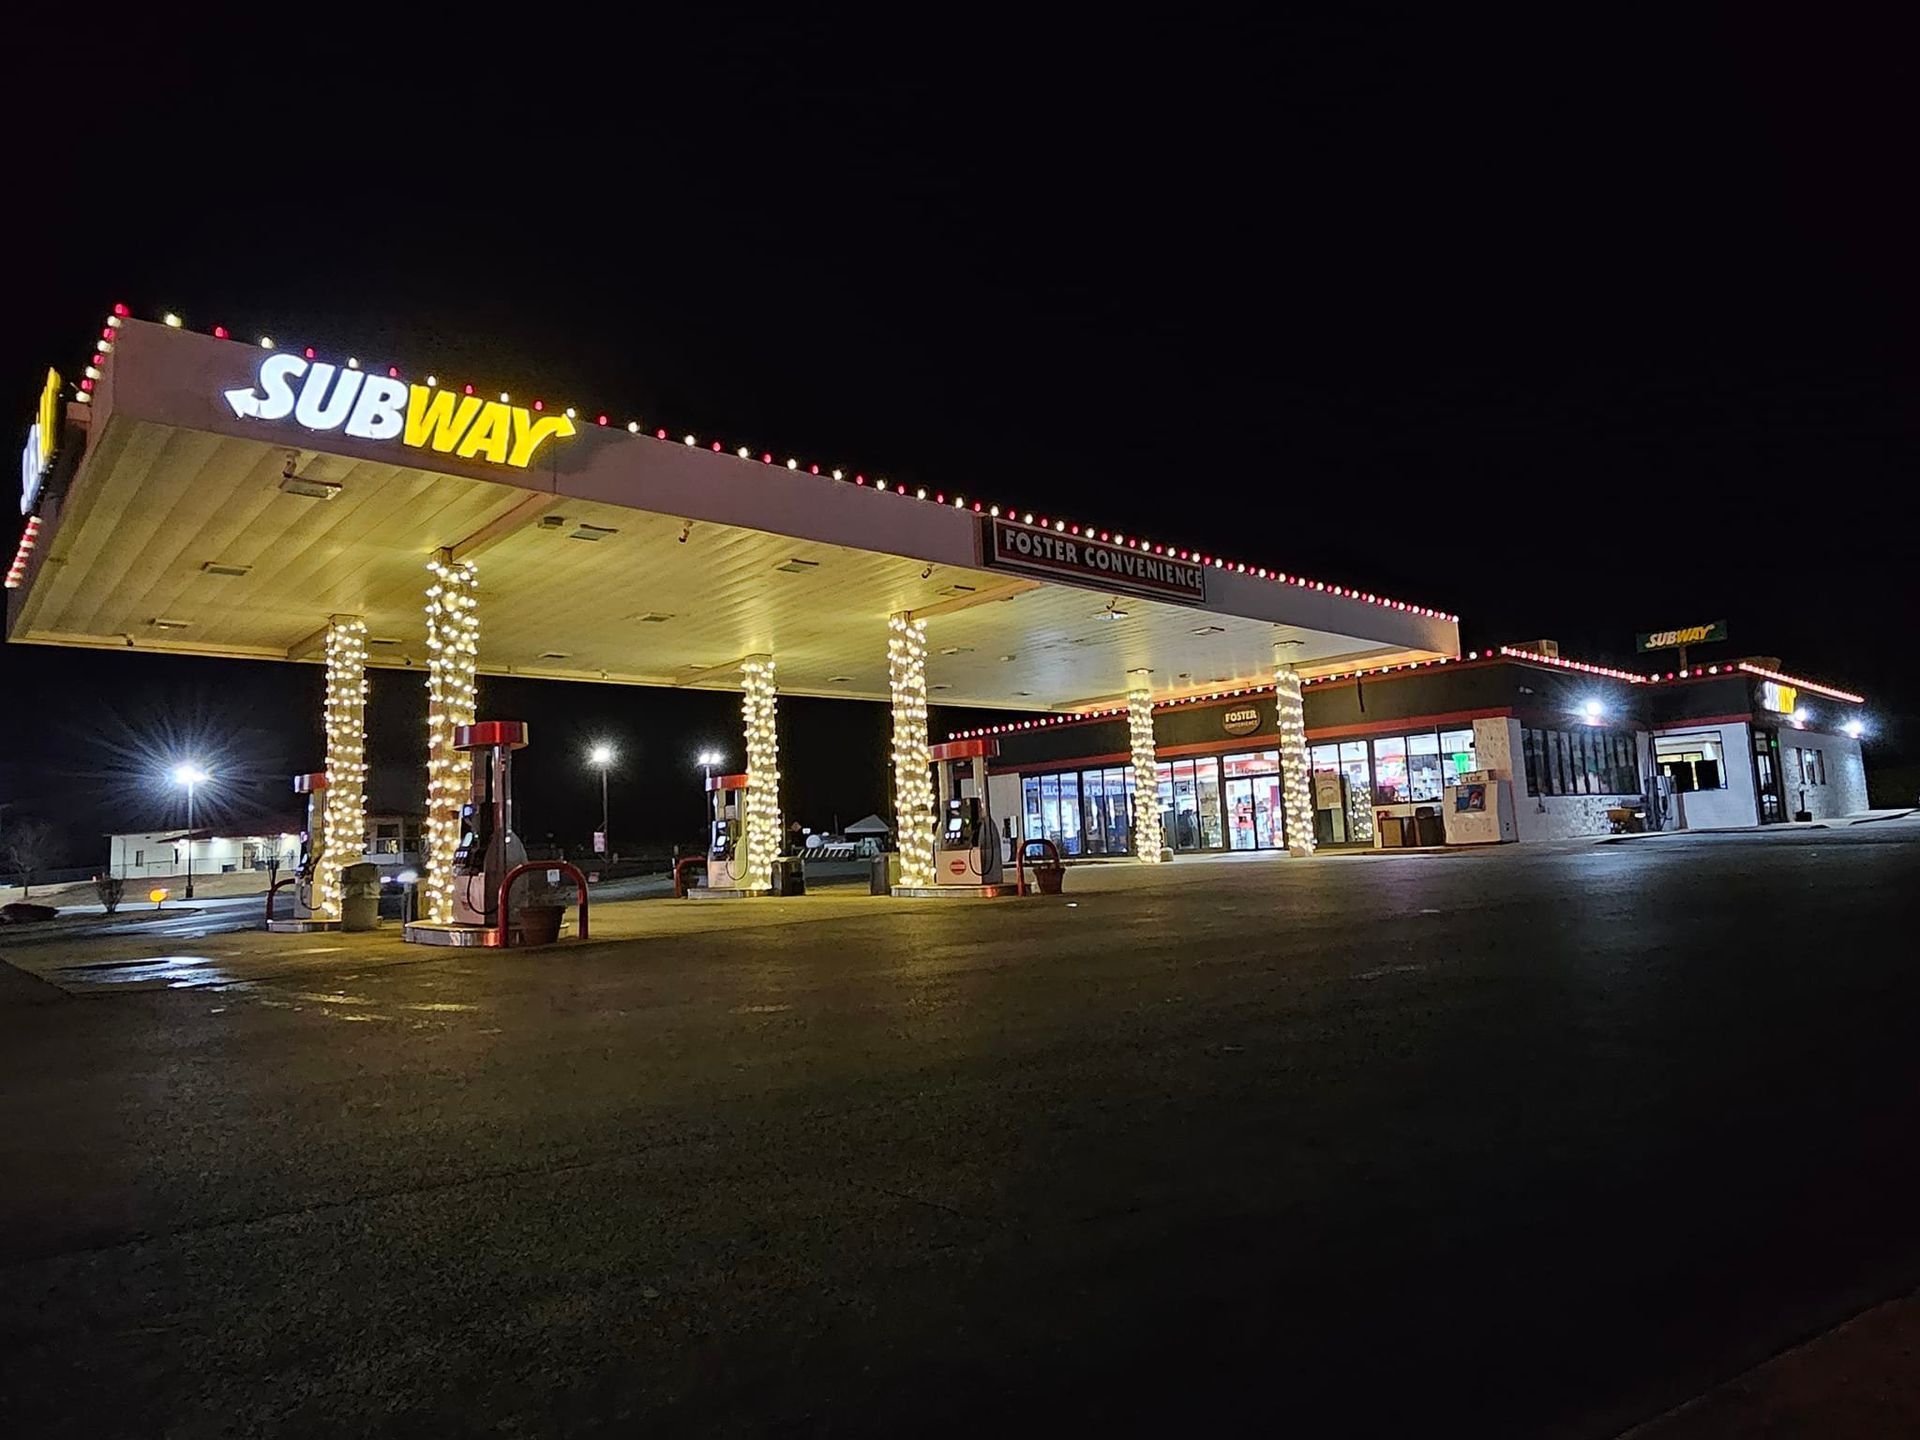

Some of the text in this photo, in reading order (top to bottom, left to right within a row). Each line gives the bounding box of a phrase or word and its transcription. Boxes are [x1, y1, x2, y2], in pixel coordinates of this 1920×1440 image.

[224, 353, 576, 468] SUBWAY
[1005, 529, 1202, 588] FOSTER CONVENIENCE
[1645, 624, 1716, 648] SUBWAY
[1225, 710, 1257, 722] FOSTER
